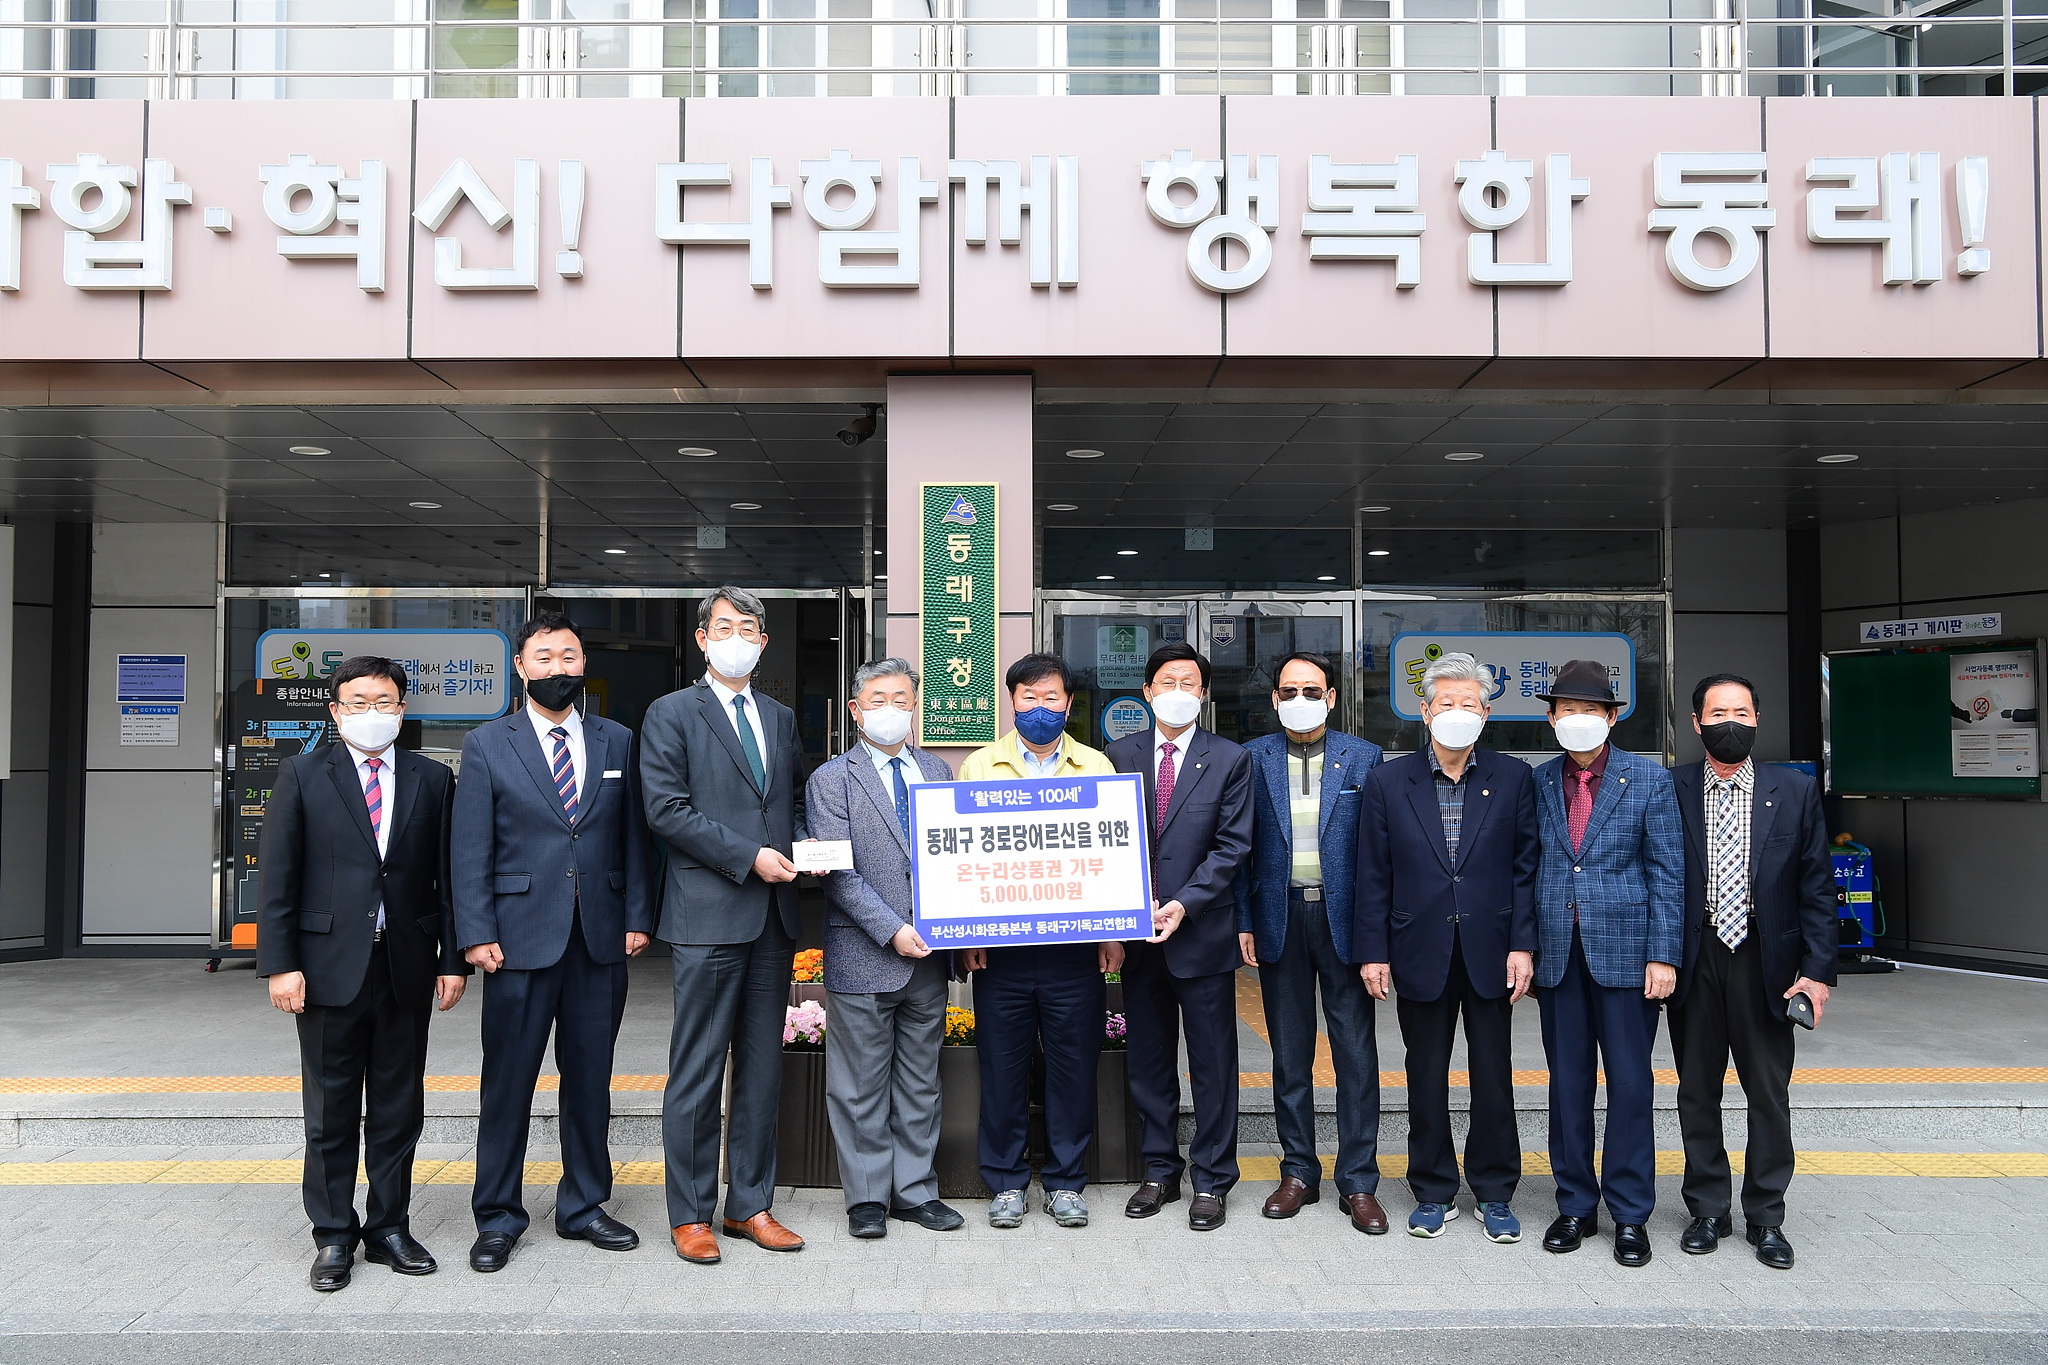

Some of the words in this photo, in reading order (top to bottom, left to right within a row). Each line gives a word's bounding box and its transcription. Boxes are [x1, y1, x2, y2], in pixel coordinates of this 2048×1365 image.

[655, 148, 1080, 292] 다함께
[1141, 149, 1590, 294] 행복한
[1647, 151, 1991, 292] 동래!
[945, 533, 974, 687] 동래구청
[1883, 623, 1919, 638] 동래구
[1924, 619, 1963, 635] 게시판
[443, 659, 495, 676] 소비하고
[1100, 654, 1126, 664] 무더위
[406, 678, 440, 695] 래에서
[443, 678, 493, 696] 즐기자!
[929, 714, 989, 725] Dongnae-gu
[1112, 709, 1143, 720] 클린존
[246, 720, 259, 730] 3F
[929, 726, 957, 735] Office
[246, 788, 258, 799] 2F
[927, 827, 974, 855] 동래구
[980, 821, 1092, 853] 경로당어르신을
[1097, 820, 1129, 847] 위한
[245, 854, 257, 865] 1F
[957, 860, 1062, 882] 온누리상품권
[1070, 857, 1104, 877] 기부
[980, 881, 1083, 904] 5,000,000원
[930, 925, 1033, 939] 부산성시화운동본부
[1036, 916, 1138, 934] 동래구기독교연합회
